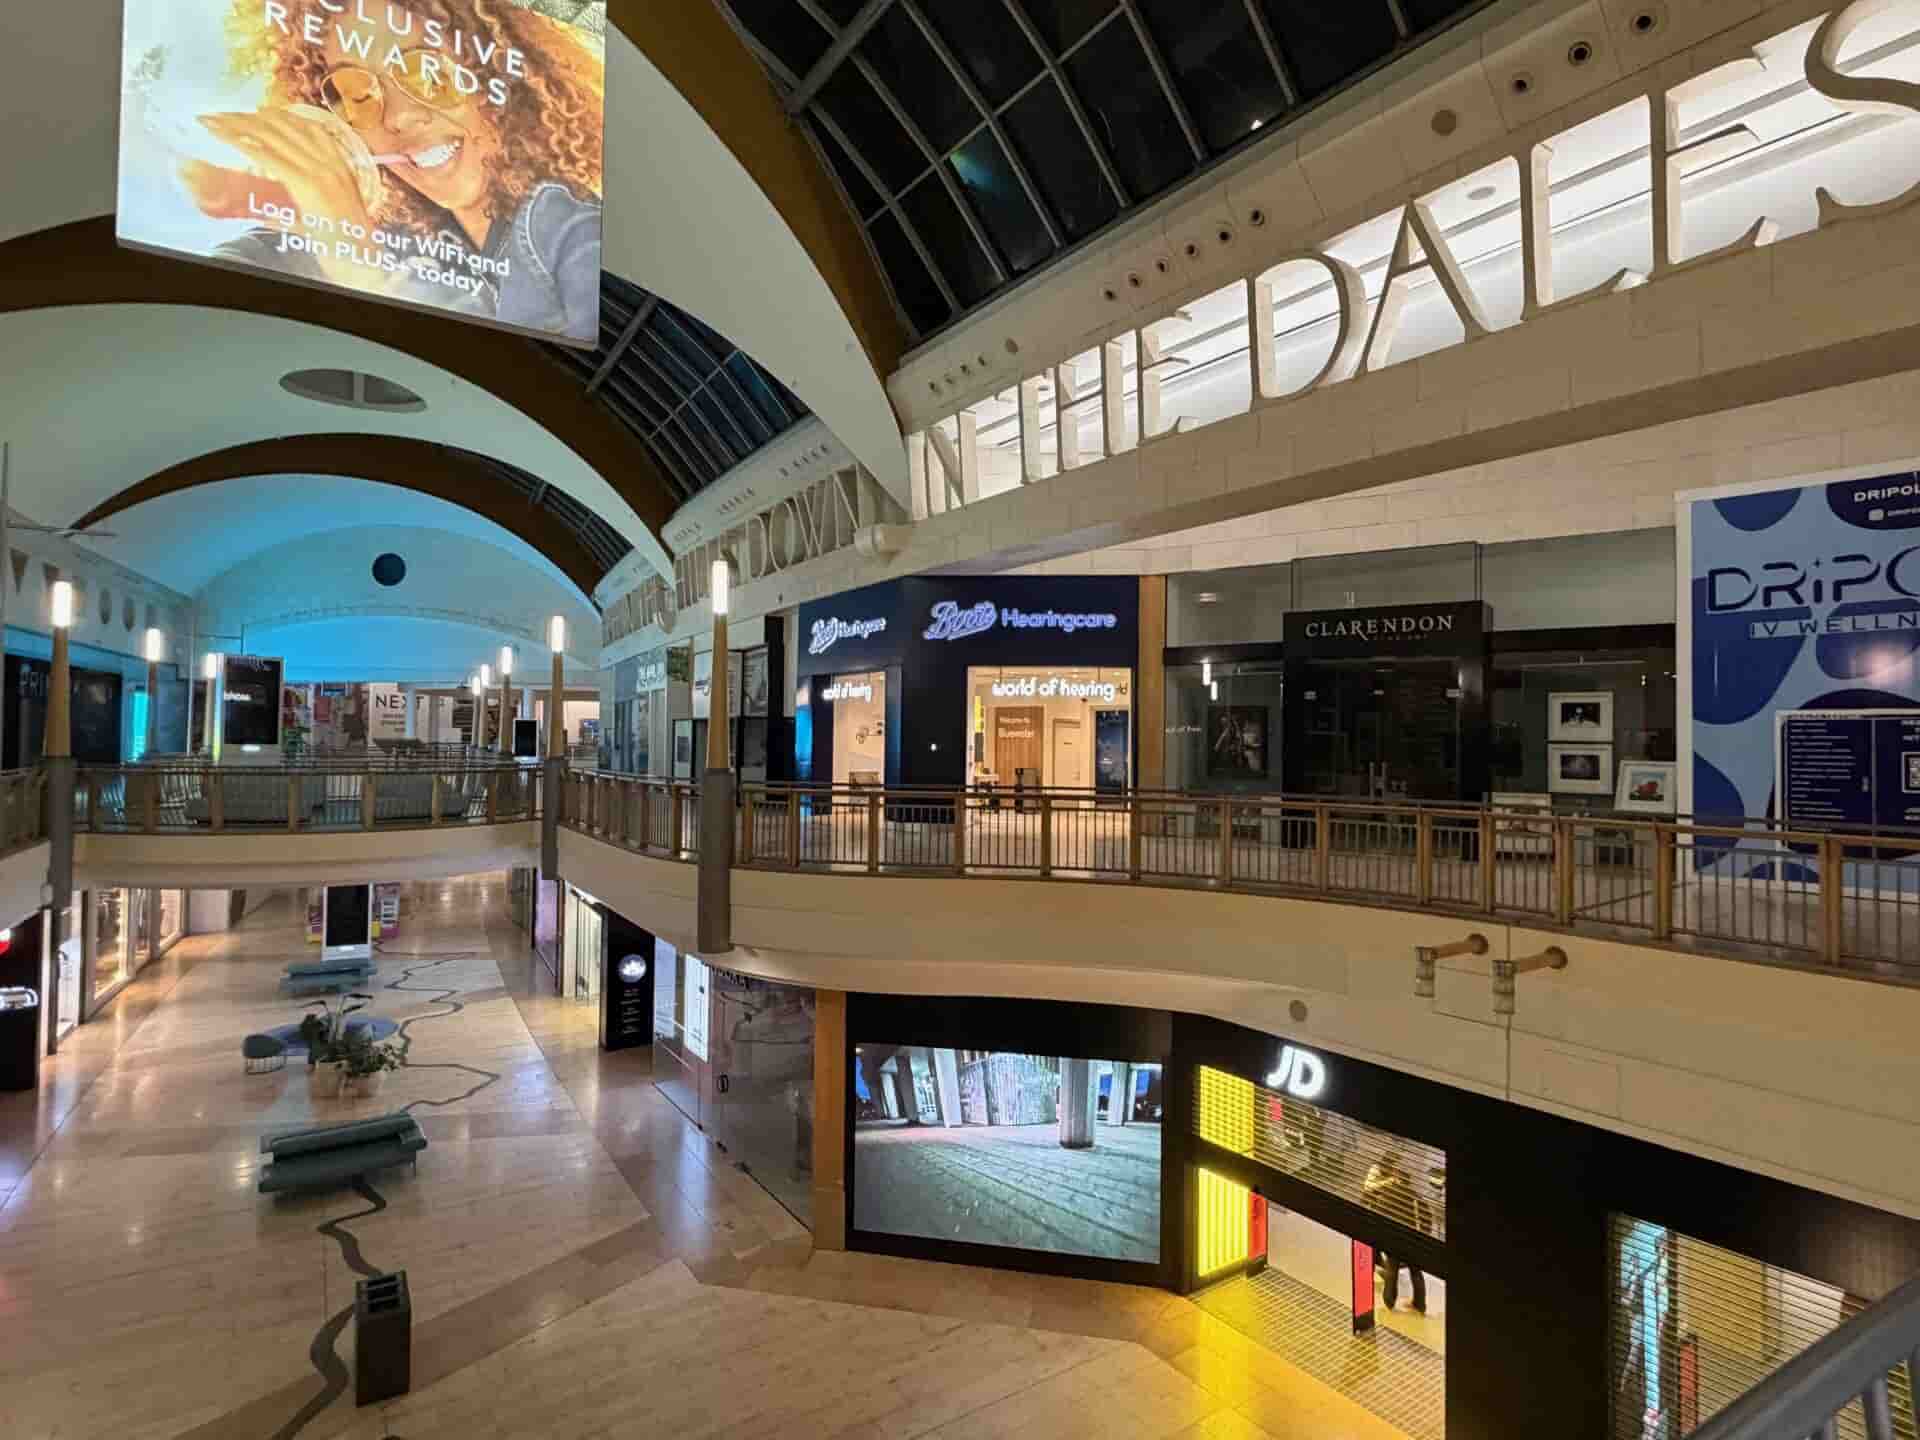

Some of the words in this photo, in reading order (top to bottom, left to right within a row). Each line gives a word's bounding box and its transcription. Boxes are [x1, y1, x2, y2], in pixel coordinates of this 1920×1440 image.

[264, 2, 507, 106] REWARDS
[249, 192, 296, 225] Log
[302, 211, 335, 232] on
[340, 215, 366, 239] to
[371, 228, 411, 250] our
[467, 250, 511, 277] and
[276, 231, 329, 257] join
[415, 262, 485, 295] today
[994, 308, 1196, 486] THE
[924, 600, 997, 640] Boots
[1001, 608, 1117, 633] Hearingcare
[1305, 616, 1453, 641] CLARENDON
[991, 676, 1036, 697] world
[1039, 677, 1058, 697] of
[1060, 677, 1115, 702] hearing
[1266, 1045, 1326, 1098] JD
